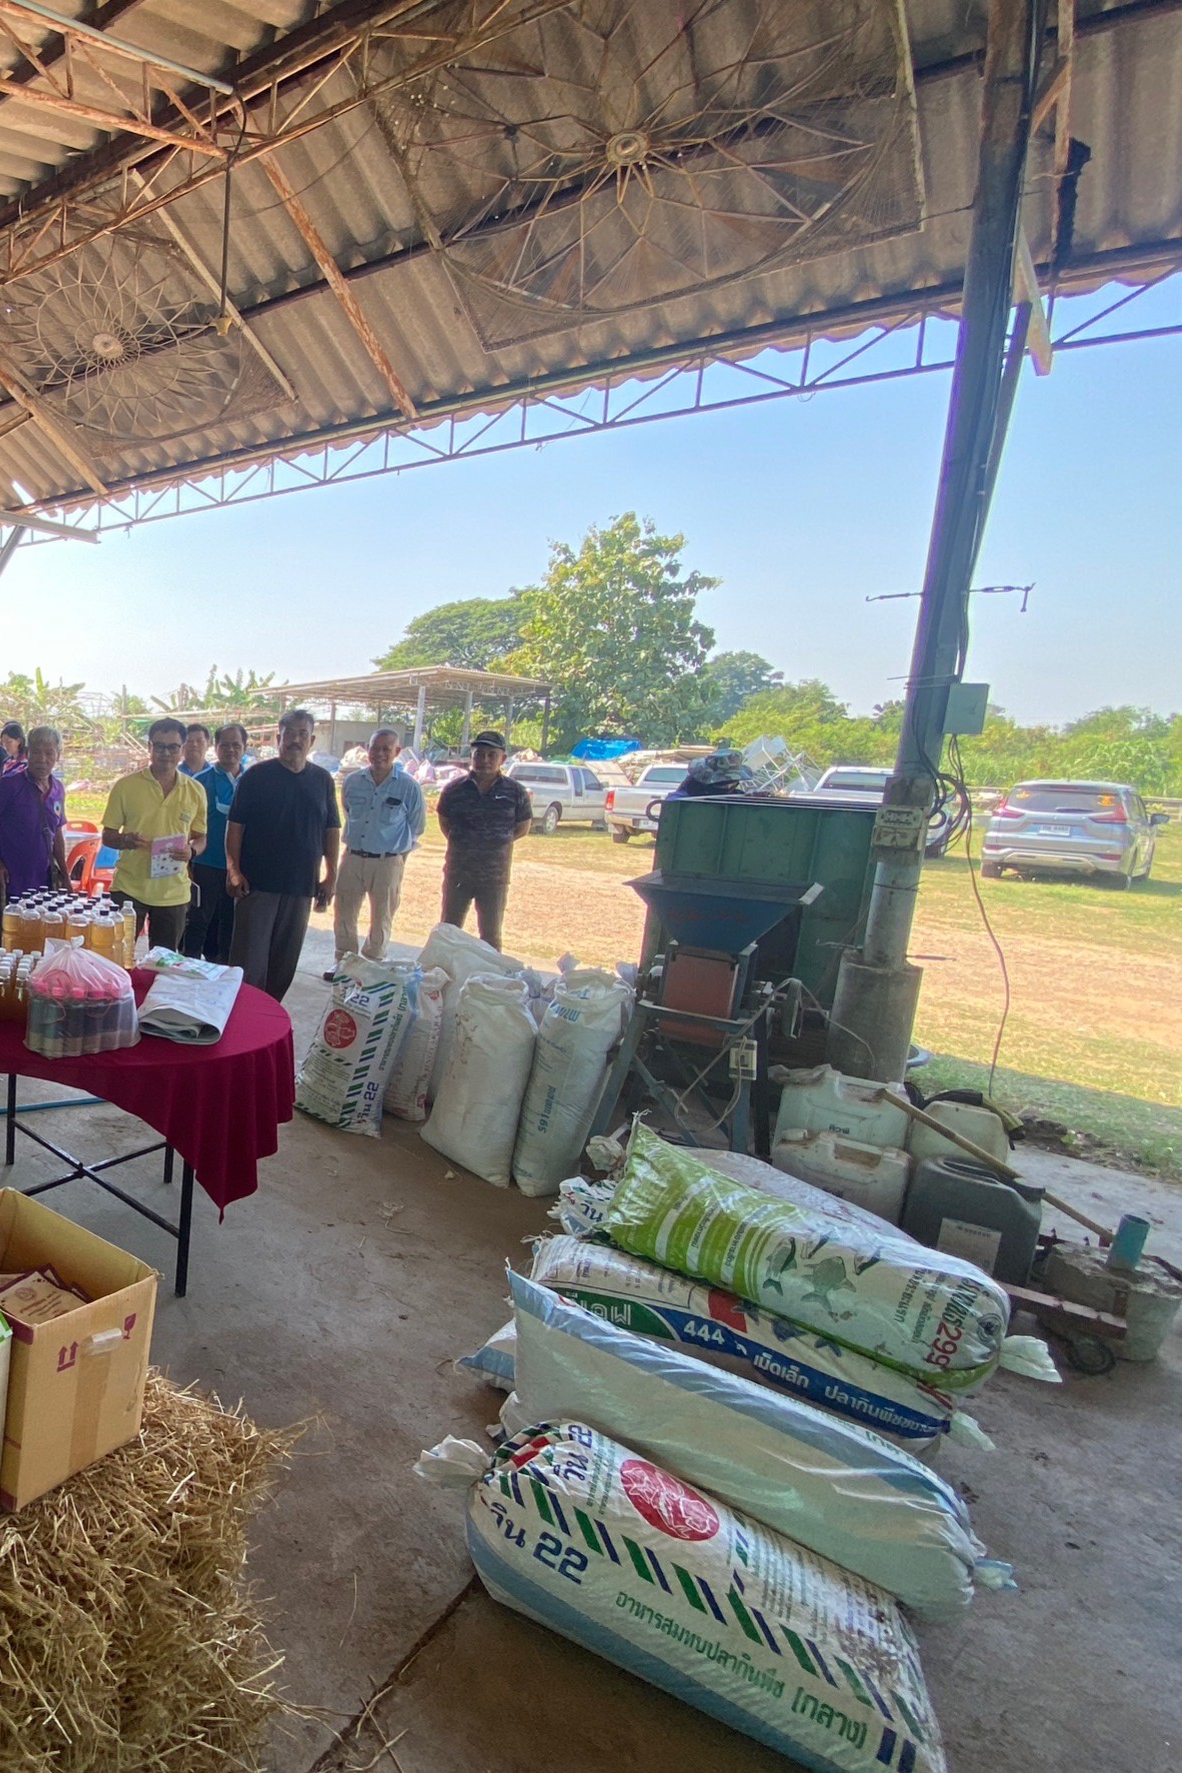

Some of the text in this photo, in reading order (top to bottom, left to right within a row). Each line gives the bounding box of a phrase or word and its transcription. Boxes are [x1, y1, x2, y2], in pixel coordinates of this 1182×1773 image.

[683, 1320, 725, 1345] 444
[753, 1352, 810, 1389] เม็ดเล็ก
[490, 1502, 588, 1585] วิน 22
[615, 1590, 786, 1699] อาหารสมทบปลากินพืช
[790, 1686, 868, 1749] (กลาง)
